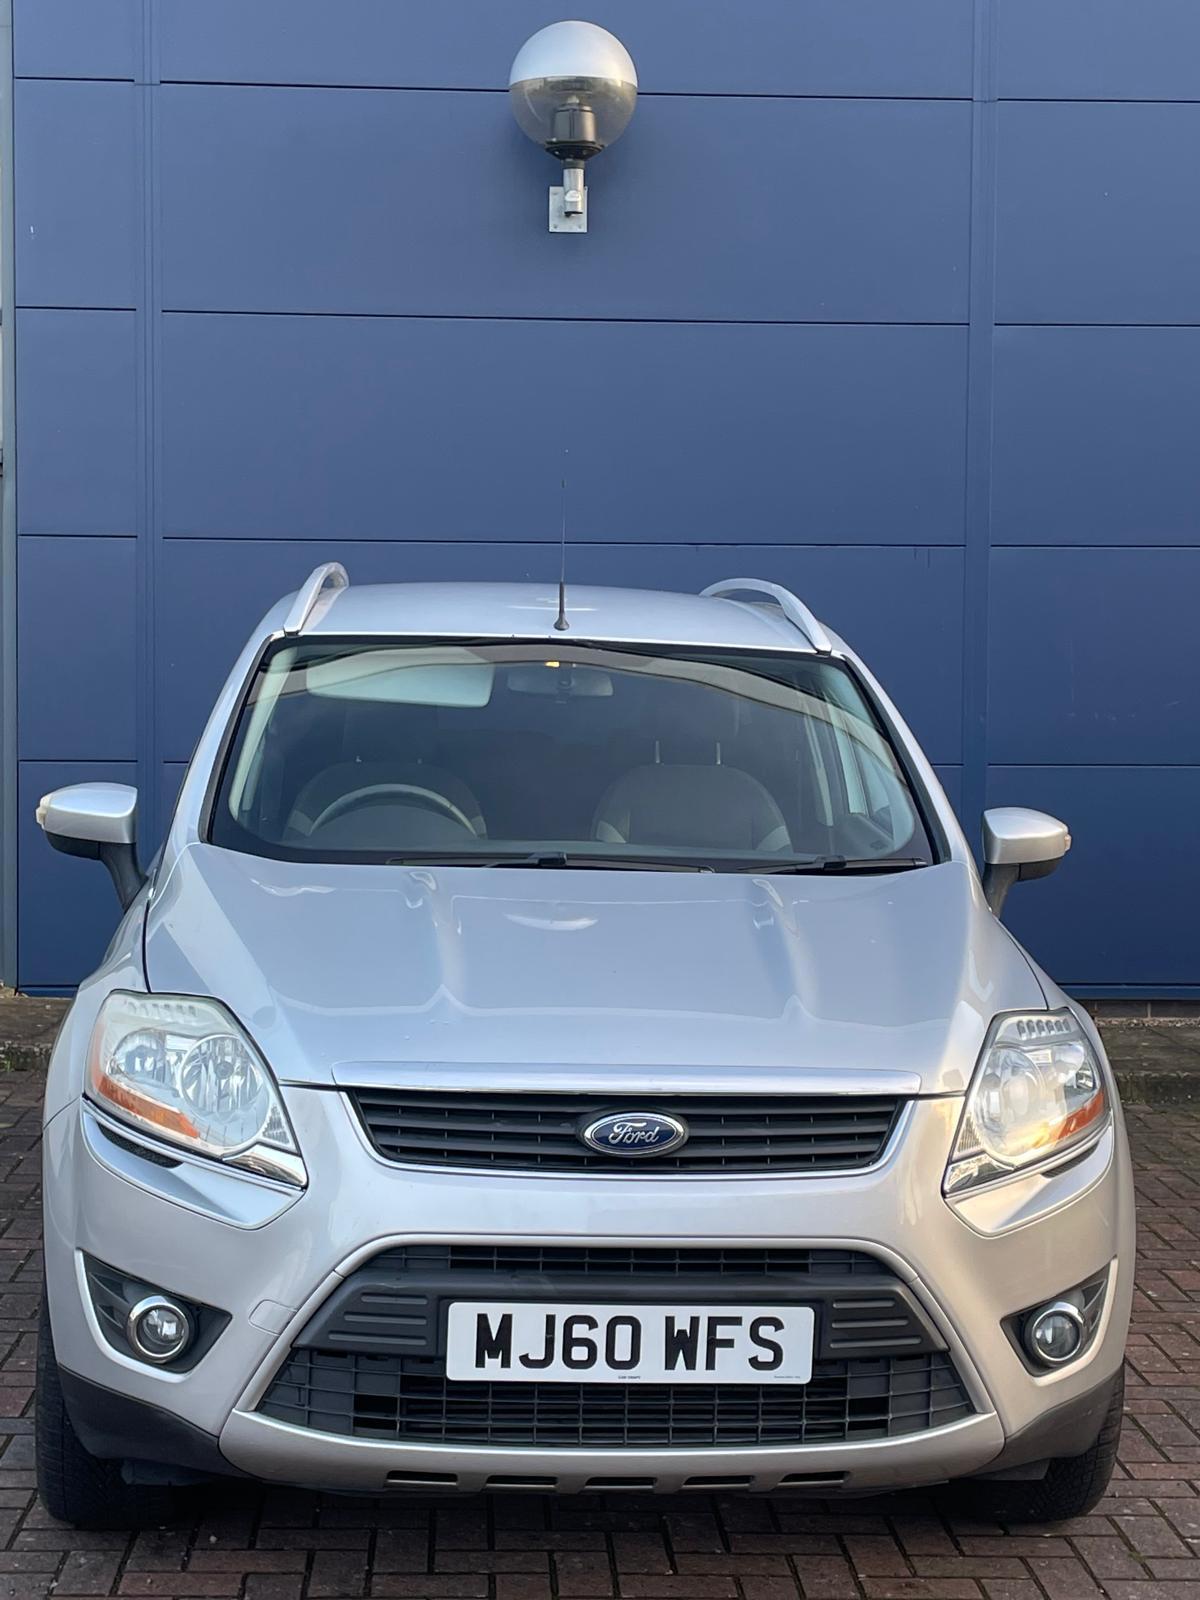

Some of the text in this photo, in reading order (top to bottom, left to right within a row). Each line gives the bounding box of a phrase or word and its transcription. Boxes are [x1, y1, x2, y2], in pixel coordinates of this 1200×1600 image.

[608, 1122, 660, 1144] Ford
[475, 1313, 785, 1371] MJ60 WFS
